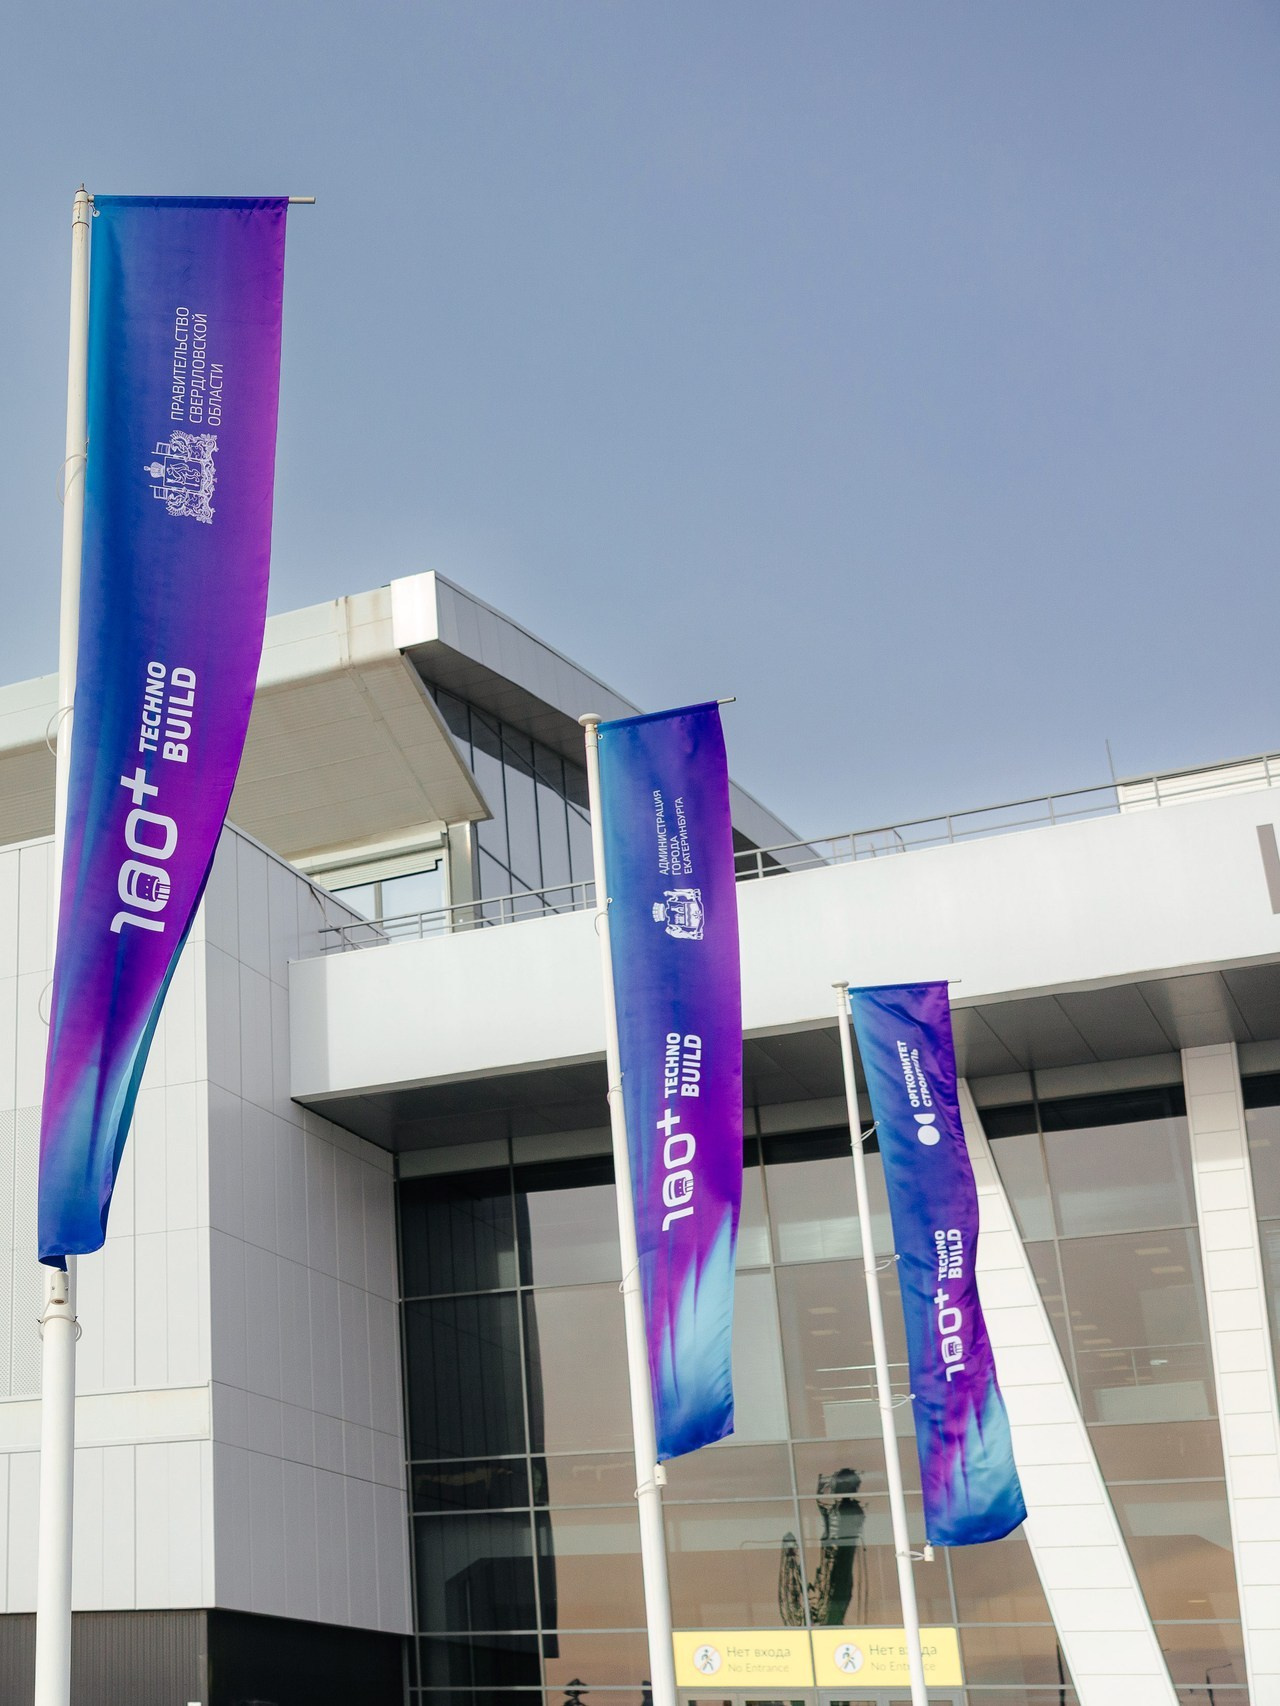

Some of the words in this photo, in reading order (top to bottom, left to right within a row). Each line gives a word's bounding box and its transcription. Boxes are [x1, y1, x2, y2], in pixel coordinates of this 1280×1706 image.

[171, 306, 190, 421] ПРАВИТЕЛЬСТВО
[189, 313, 208, 424] СВЕРДЛОВСКОЙ
[207, 363, 224, 427] ОБЛАСТИ
[138, 660, 167, 752] TECHNO
[162, 666, 197, 764] BUILD
[109, 767, 179, 934] 100+
[652, 789, 670, 876] АДМИНИСТРАЦИЯ
[670, 835, 682, 876] ГОРОДА
[674, 796, 693, 875] ЕКАТЕРИНБУРГА
[664, 1032, 681, 1099] TECHNO
[680, 1034, 702, 1098] BUILD
[896, 1040, 921, 1108] ОРГКОМИТЕТ
[656, 1108, 697, 1232] 100+
[934, 1229, 949, 1282] TECHNO
[946, 1228, 964, 1280] BUILD
[934, 1288, 966, 1382] 100+
[726, 1646, 751, 1658] Нет
[754, 1648, 791, 1659] входа
[727, 1663, 744, 1673] No
[745, 1662, 790, 1673] Entrance
[869, 1644, 895, 1656] Нет
[898, 1646, 938, 1658] вда
[871, 1661, 887, 1671] No
